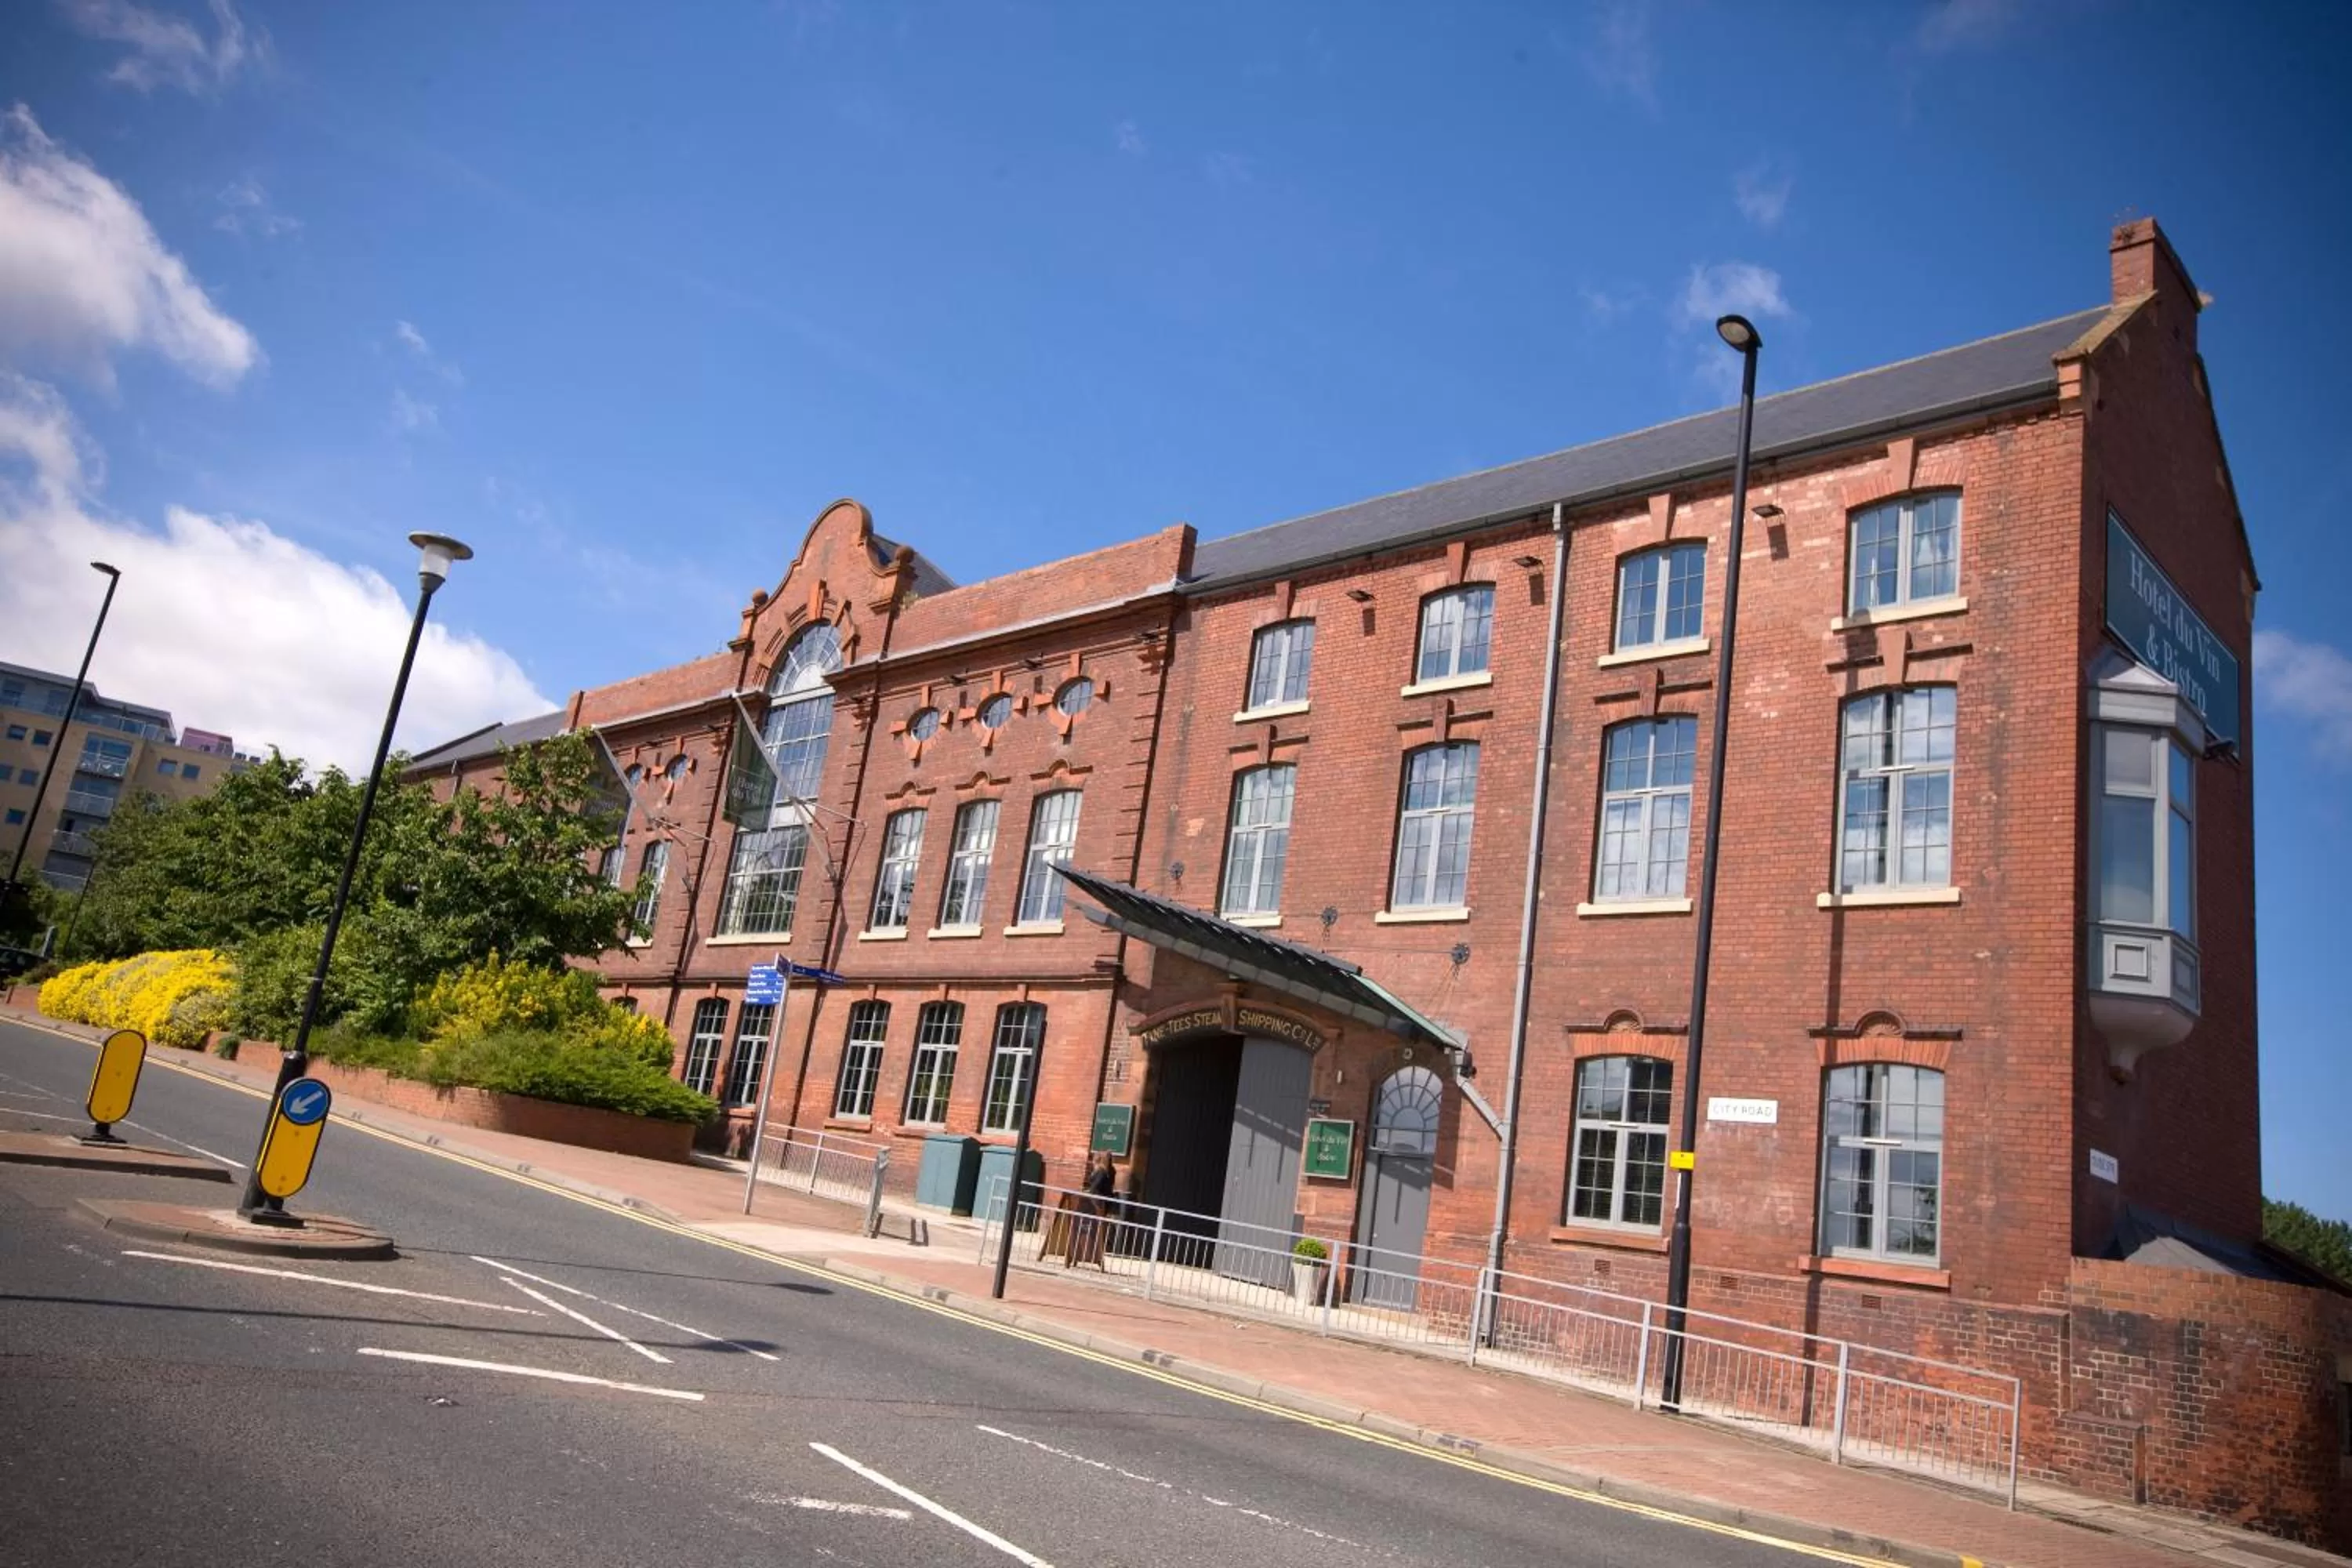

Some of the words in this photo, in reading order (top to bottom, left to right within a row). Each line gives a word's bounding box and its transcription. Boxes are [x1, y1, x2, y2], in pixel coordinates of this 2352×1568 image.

[2130, 550, 2172, 630] Hotel
[2175, 608, 2193, 653] du
[2197, 626, 2220, 683] Vin
[2146, 623, 2159, 666] &
[2163, 639, 2208, 716] Bistro
[1239, 1009, 1291, 1036] SHIPPING
[1712, 1103, 1738, 1115] CITY
[1741, 1105, 1773, 1117] ROAD
